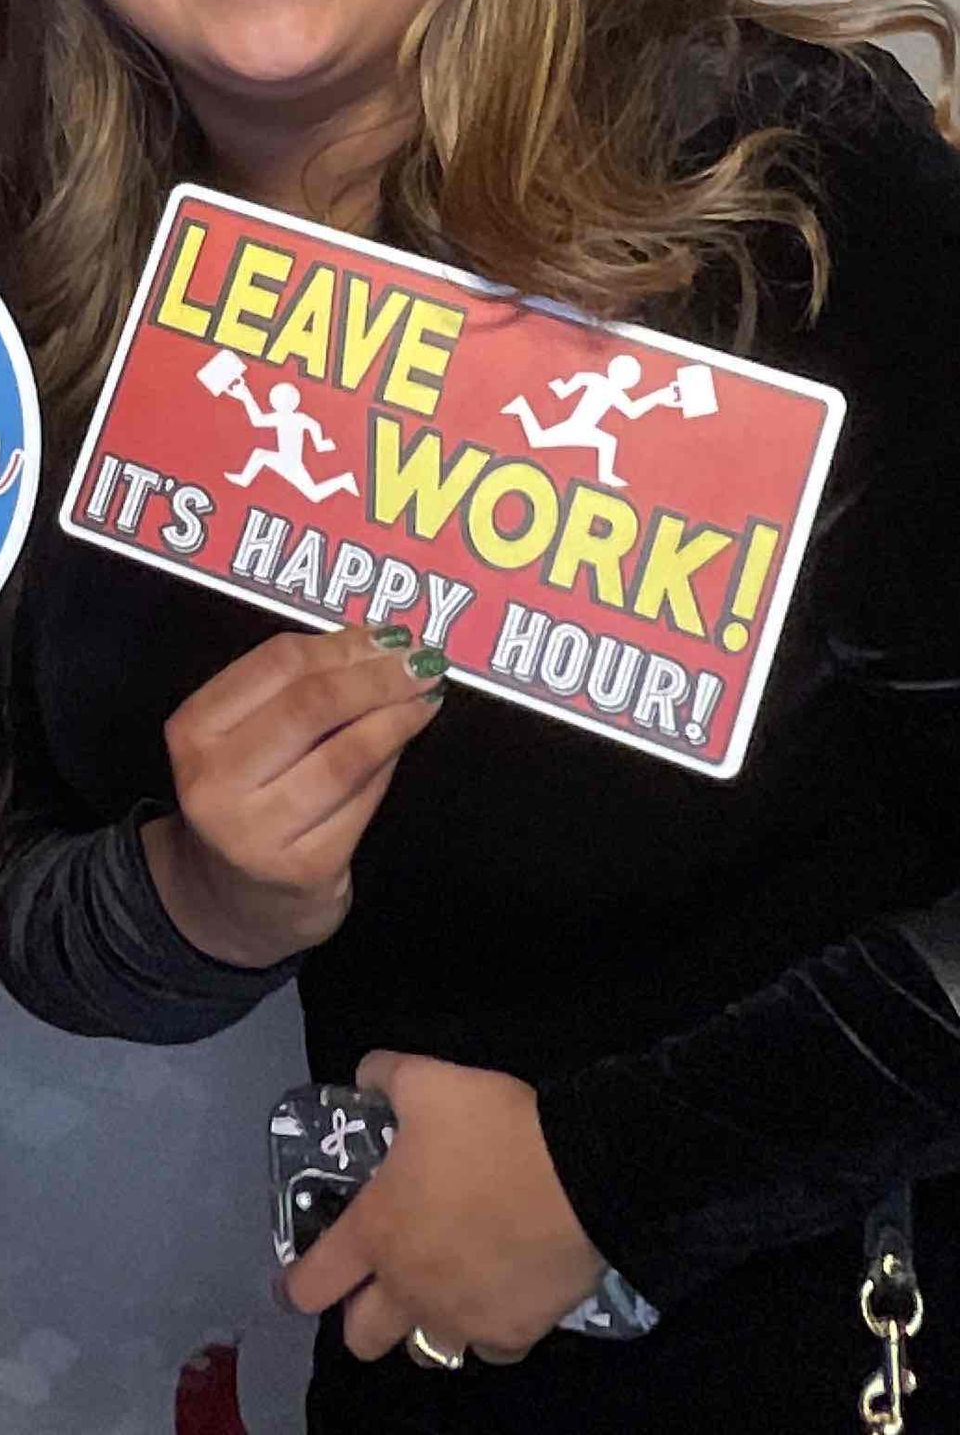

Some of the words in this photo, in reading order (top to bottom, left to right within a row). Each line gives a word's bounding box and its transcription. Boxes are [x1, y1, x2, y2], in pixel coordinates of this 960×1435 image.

[152, 219, 464, 419] LEAVE
[85, 453, 214, 554] IT'S
[231, 507, 474, 649] HAPPY
[491, 600, 725, 746] HOUR!
[368, 407, 781, 653] WORK!
